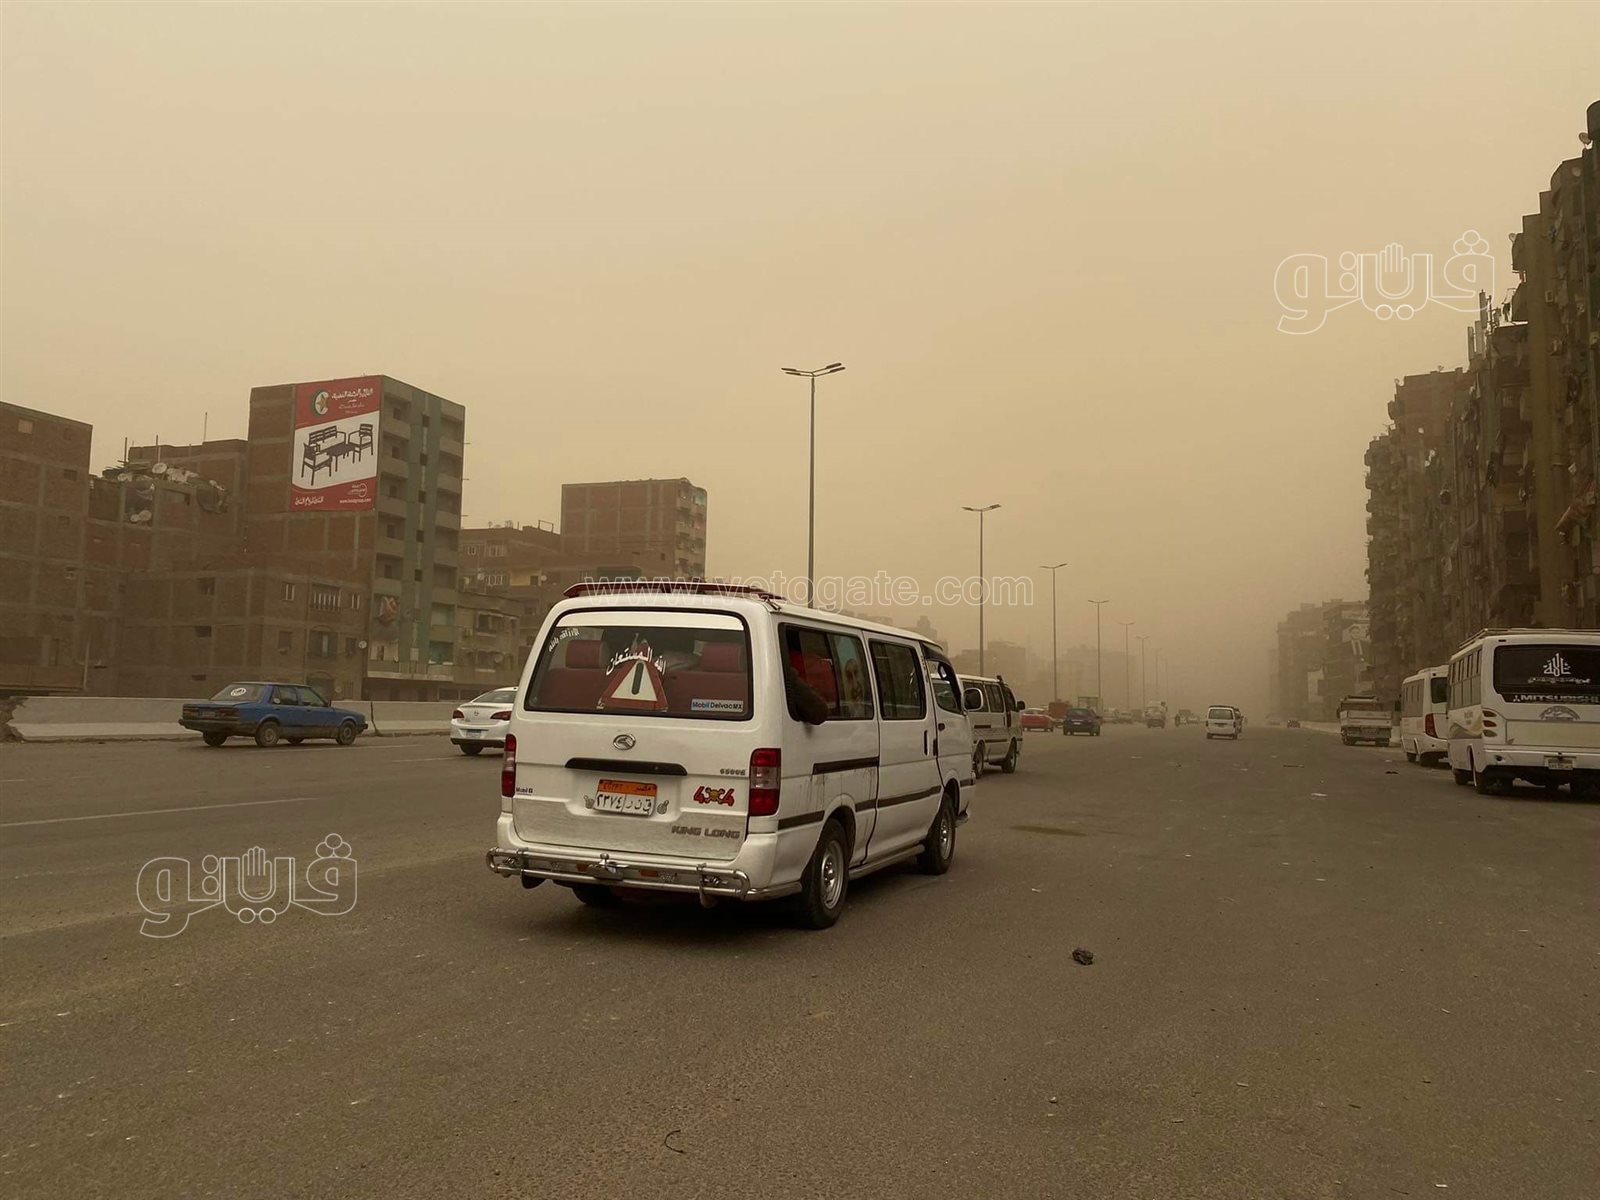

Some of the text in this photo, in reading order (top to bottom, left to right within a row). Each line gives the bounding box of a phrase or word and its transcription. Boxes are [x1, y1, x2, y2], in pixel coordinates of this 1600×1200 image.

[606, 646, 667, 676] الله المستعان
[692, 701, 709, 709] Mobil
[671, 825, 741, 839] KING LONG
